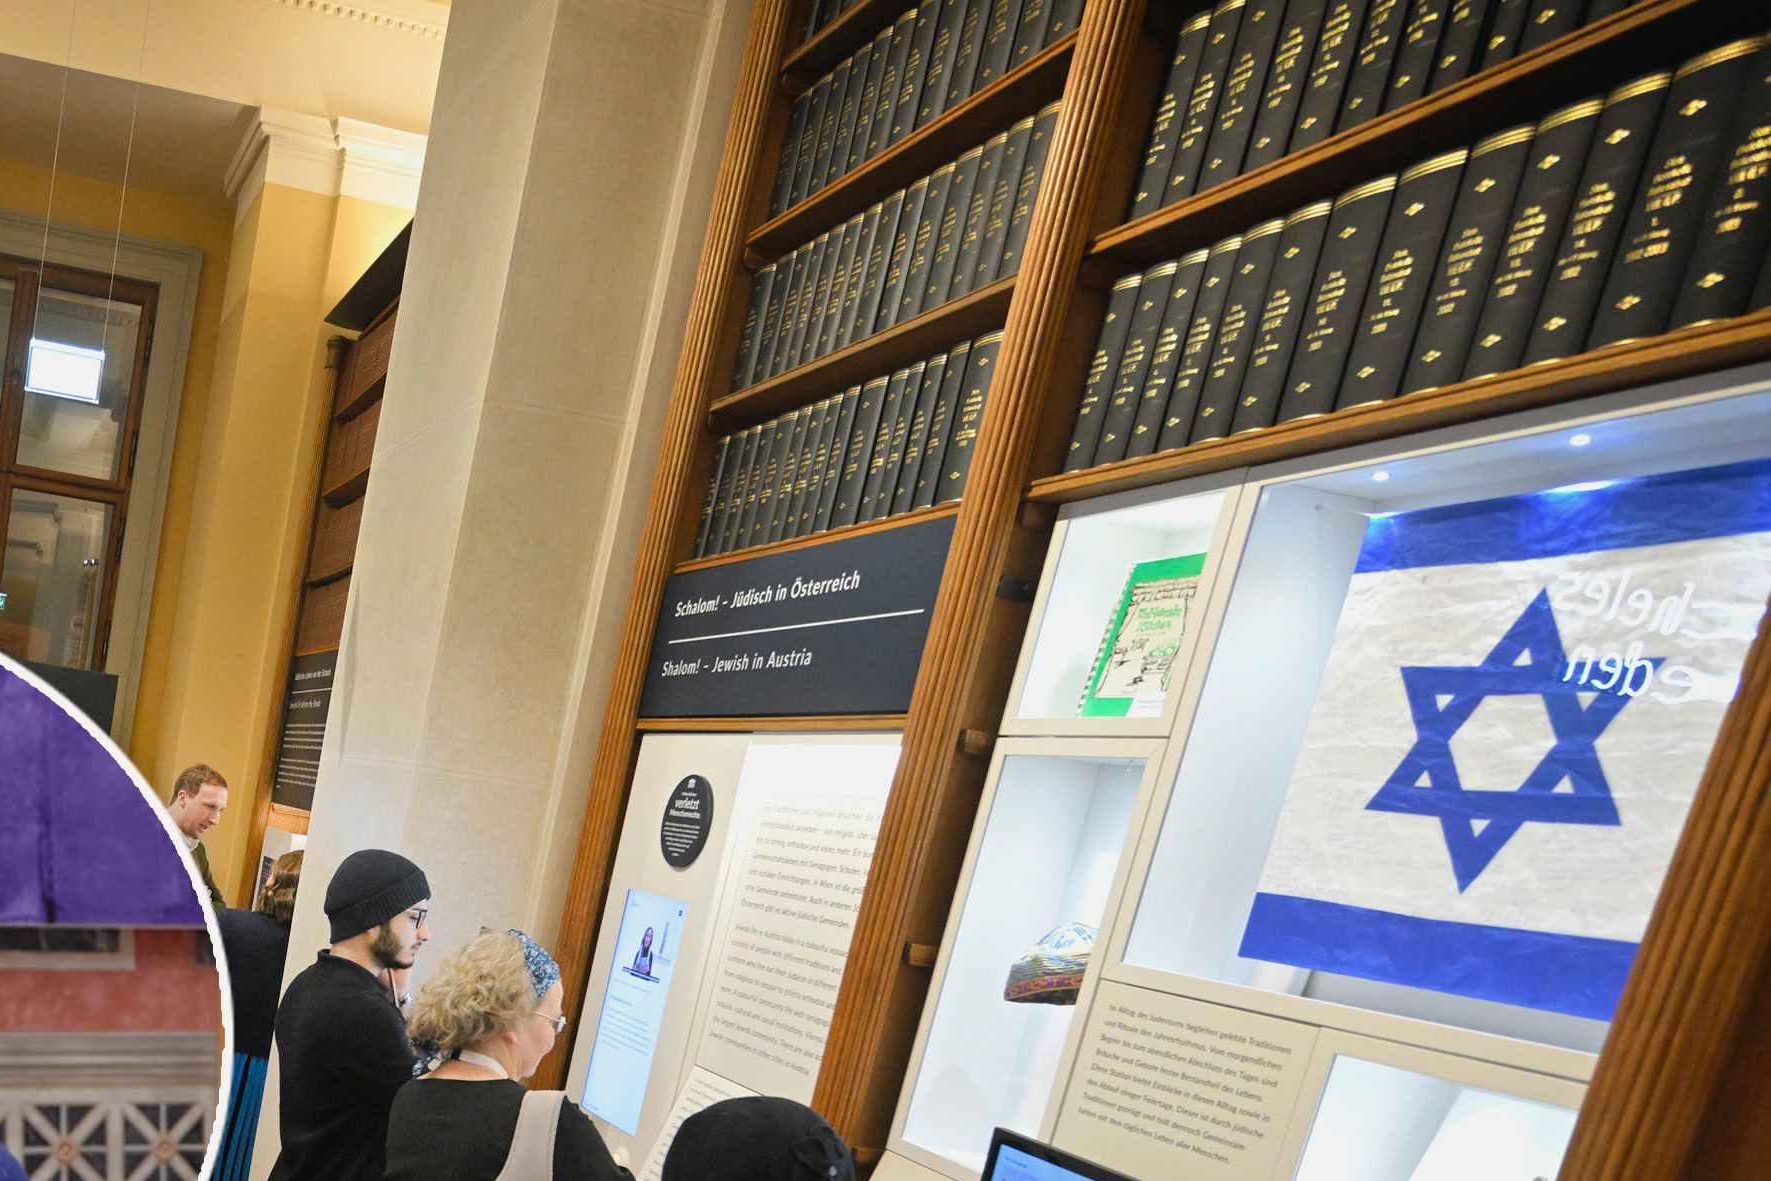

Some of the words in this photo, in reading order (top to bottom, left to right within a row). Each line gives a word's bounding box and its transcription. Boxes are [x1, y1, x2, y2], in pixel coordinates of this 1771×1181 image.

[675, 594, 720, 618] Schalom!
[729, 585, 773, 609] Jüdisch
[774, 584, 788, 600] in
[790, 570, 861, 599] Österreich
[661, 658, 701, 677] Shalom!
[711, 651, 749, 673] Jewish
[751, 651, 764, 669] in
[766, 647, 812, 668] Austria
[675, 797, 700, 810] verletzt
